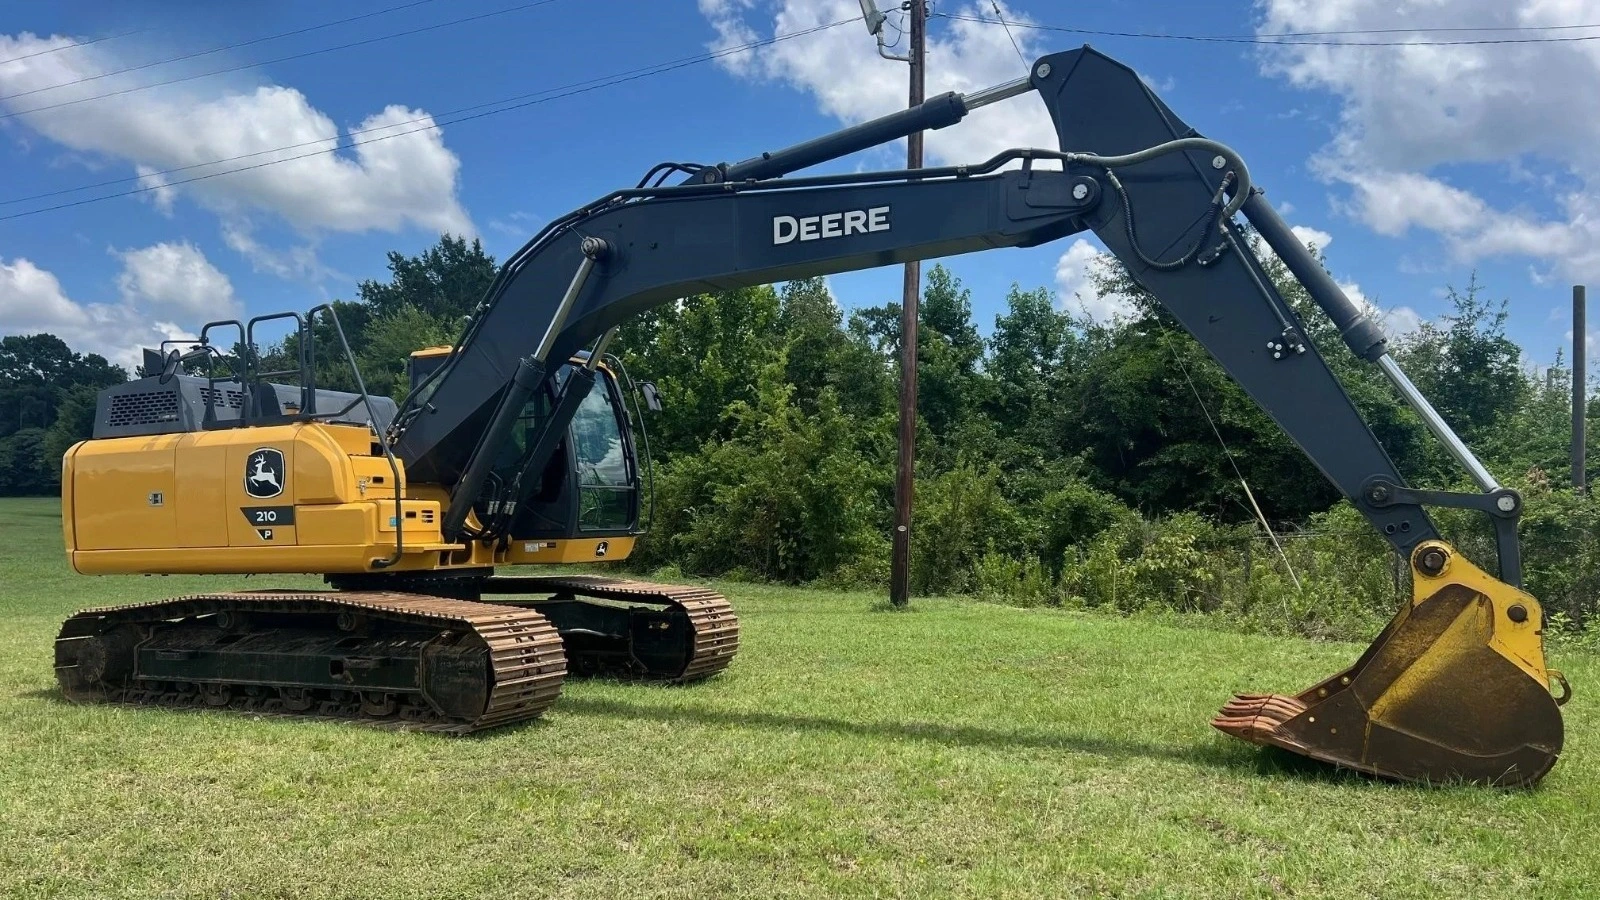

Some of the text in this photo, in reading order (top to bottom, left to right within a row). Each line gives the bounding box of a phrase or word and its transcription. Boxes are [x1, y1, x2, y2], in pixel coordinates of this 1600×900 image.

[773, 206, 890, 245] DEERE
[256, 511, 277, 522] 210
[264, 530, 272, 539] P
